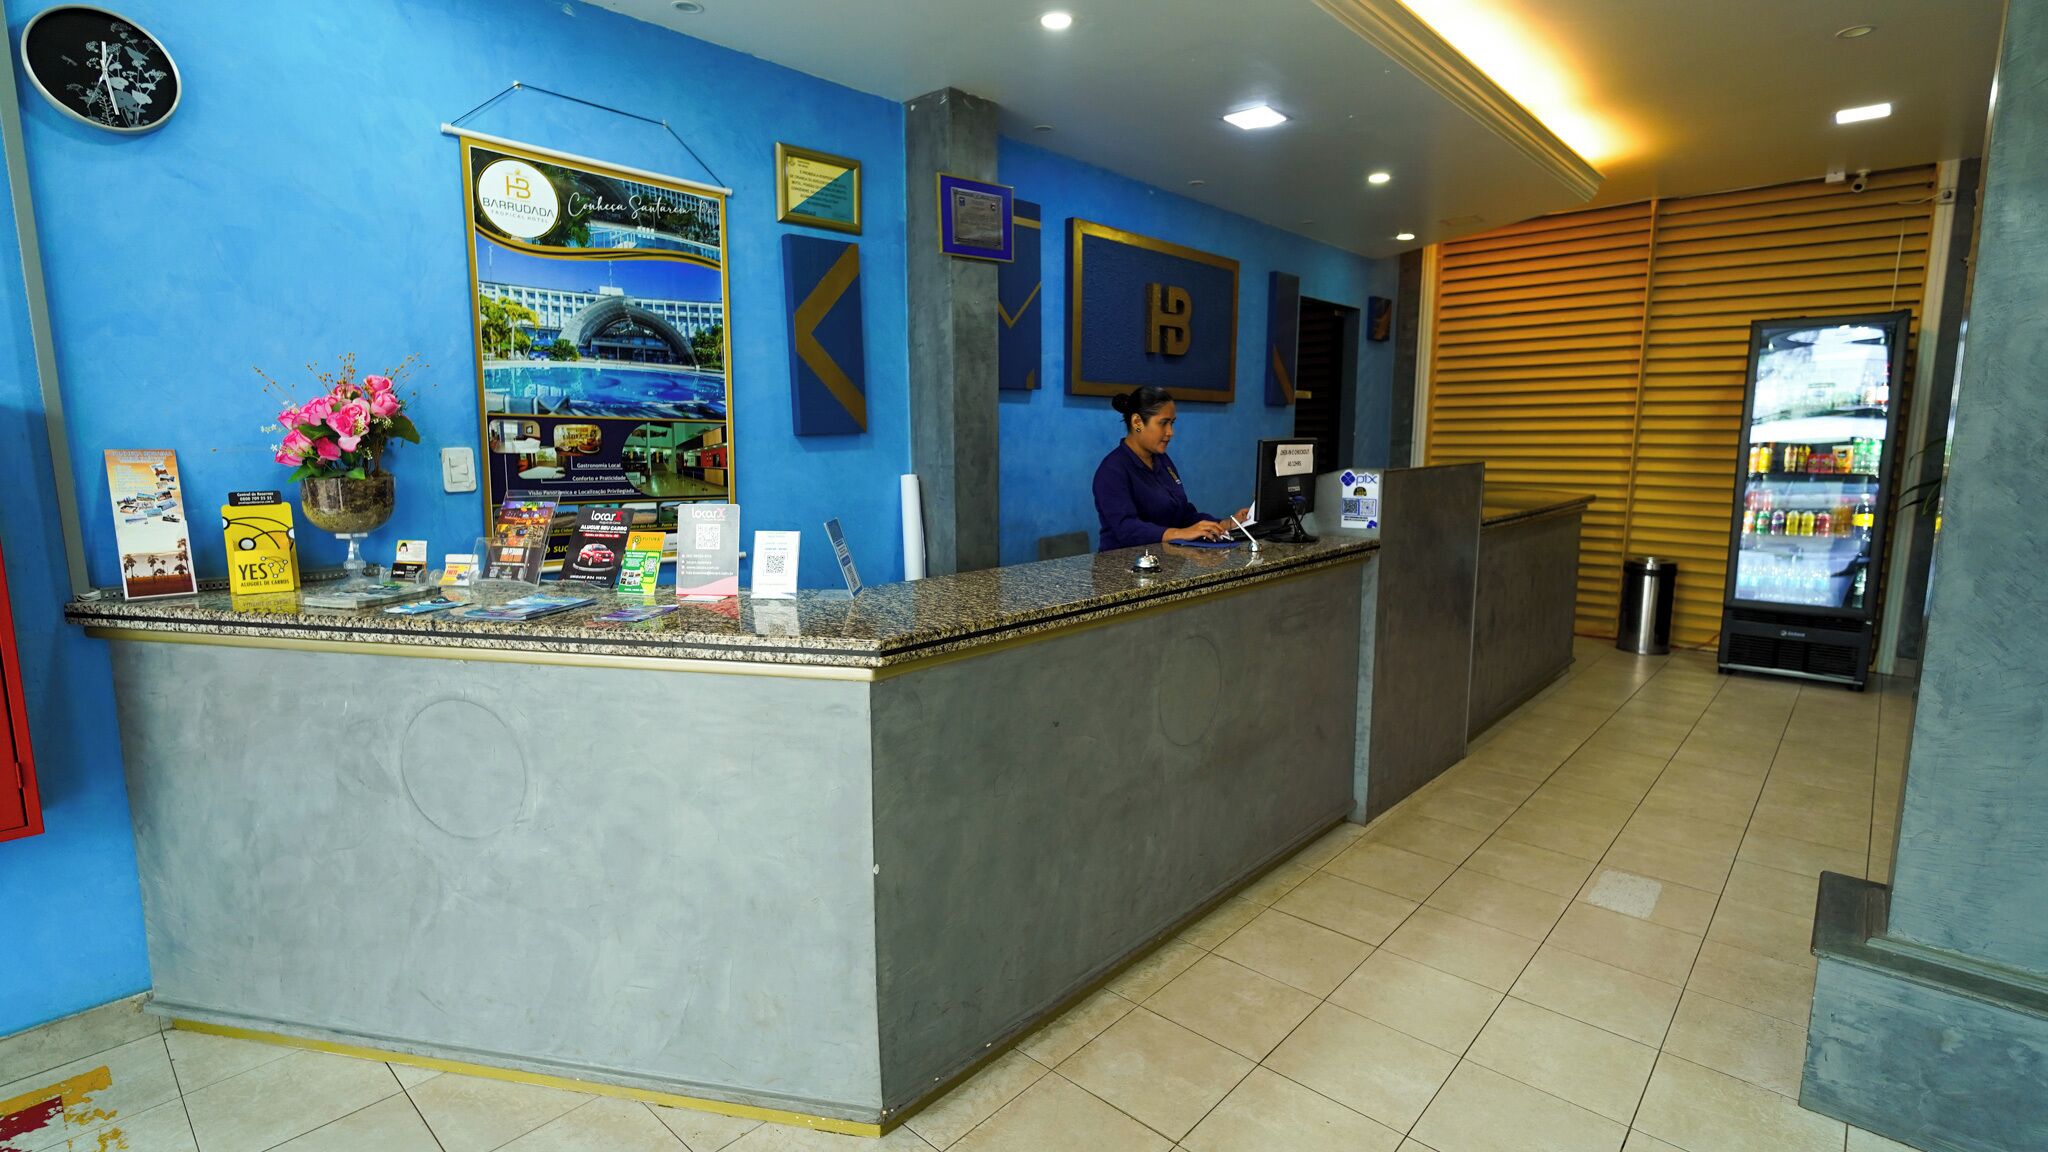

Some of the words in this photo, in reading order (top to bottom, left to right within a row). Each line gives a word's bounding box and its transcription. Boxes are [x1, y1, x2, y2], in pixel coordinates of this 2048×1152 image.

[482, 197, 554, 218] BARRUDADA
[568, 191, 627, 217] Conheça
[1146, 282, 1192, 356] HB
[1356, 474, 1377, 486] pix
[238, 562, 268, 581] YES
